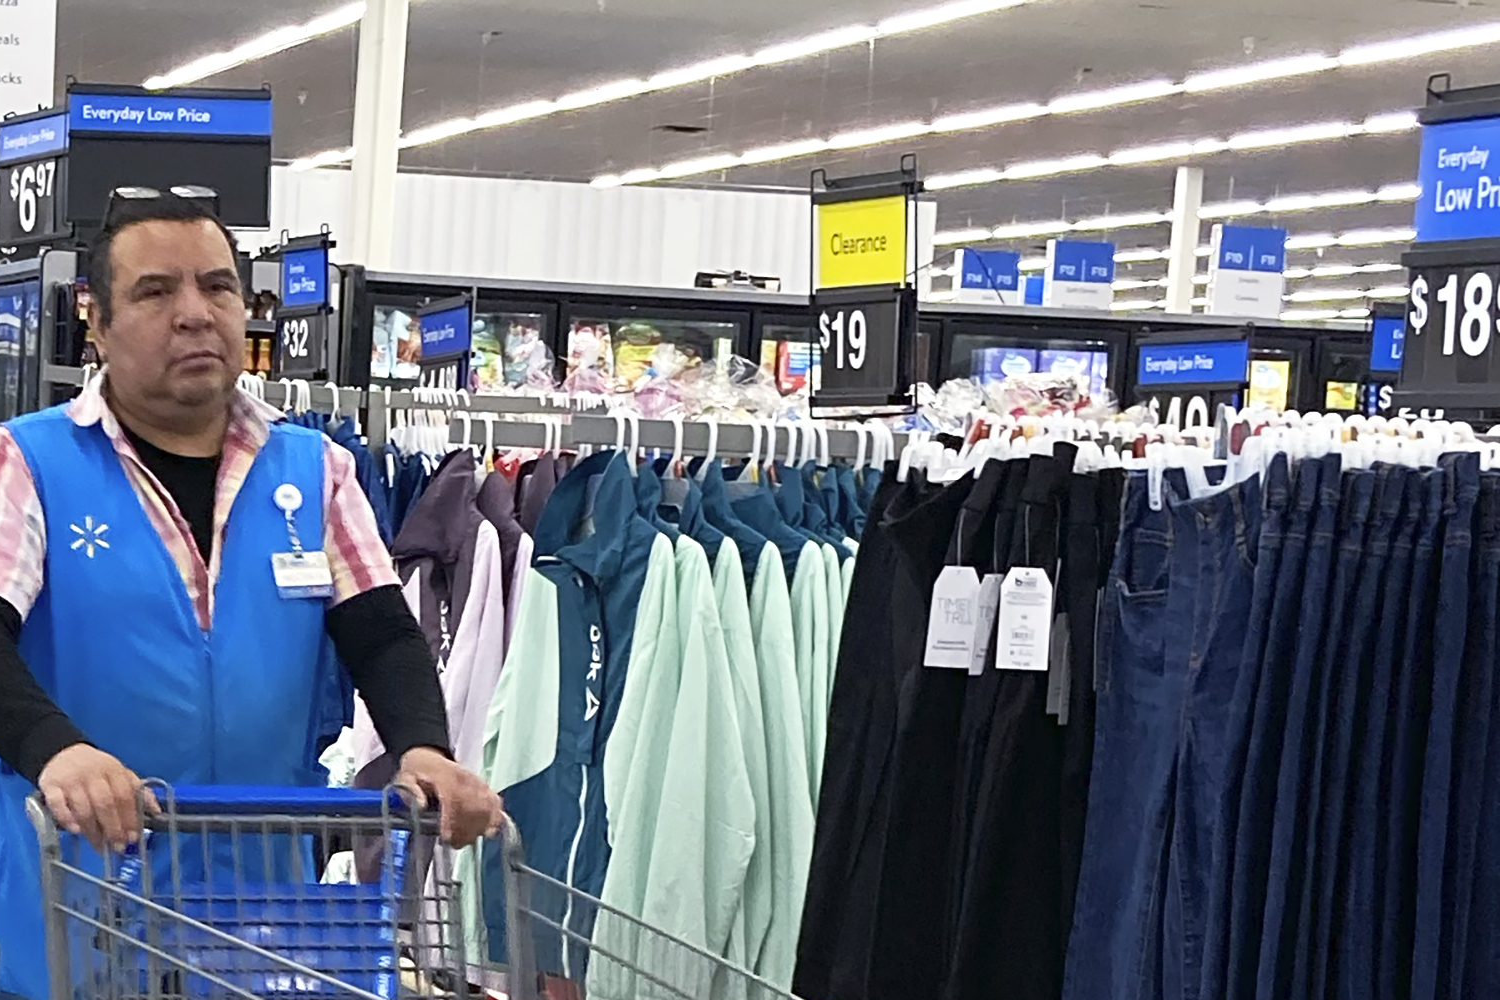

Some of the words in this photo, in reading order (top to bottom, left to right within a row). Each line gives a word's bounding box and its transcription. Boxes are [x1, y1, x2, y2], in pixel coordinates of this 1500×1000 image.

[82, 105, 144, 123] Everyday
[147, 107, 174, 122] Low
[177, 108, 211, 123] Price
[1438, 147, 1489, 171] Everyday
[1435, 180, 1473, 212] Low
[830, 233, 887, 256] Clearance
[283, 318, 309, 358] $32
[819, 309, 867, 370] $19
[1145, 356, 1178, 374] Everyday
[1178, 356, 1193, 370] Low
[1193, 354, 1214, 370] Price
